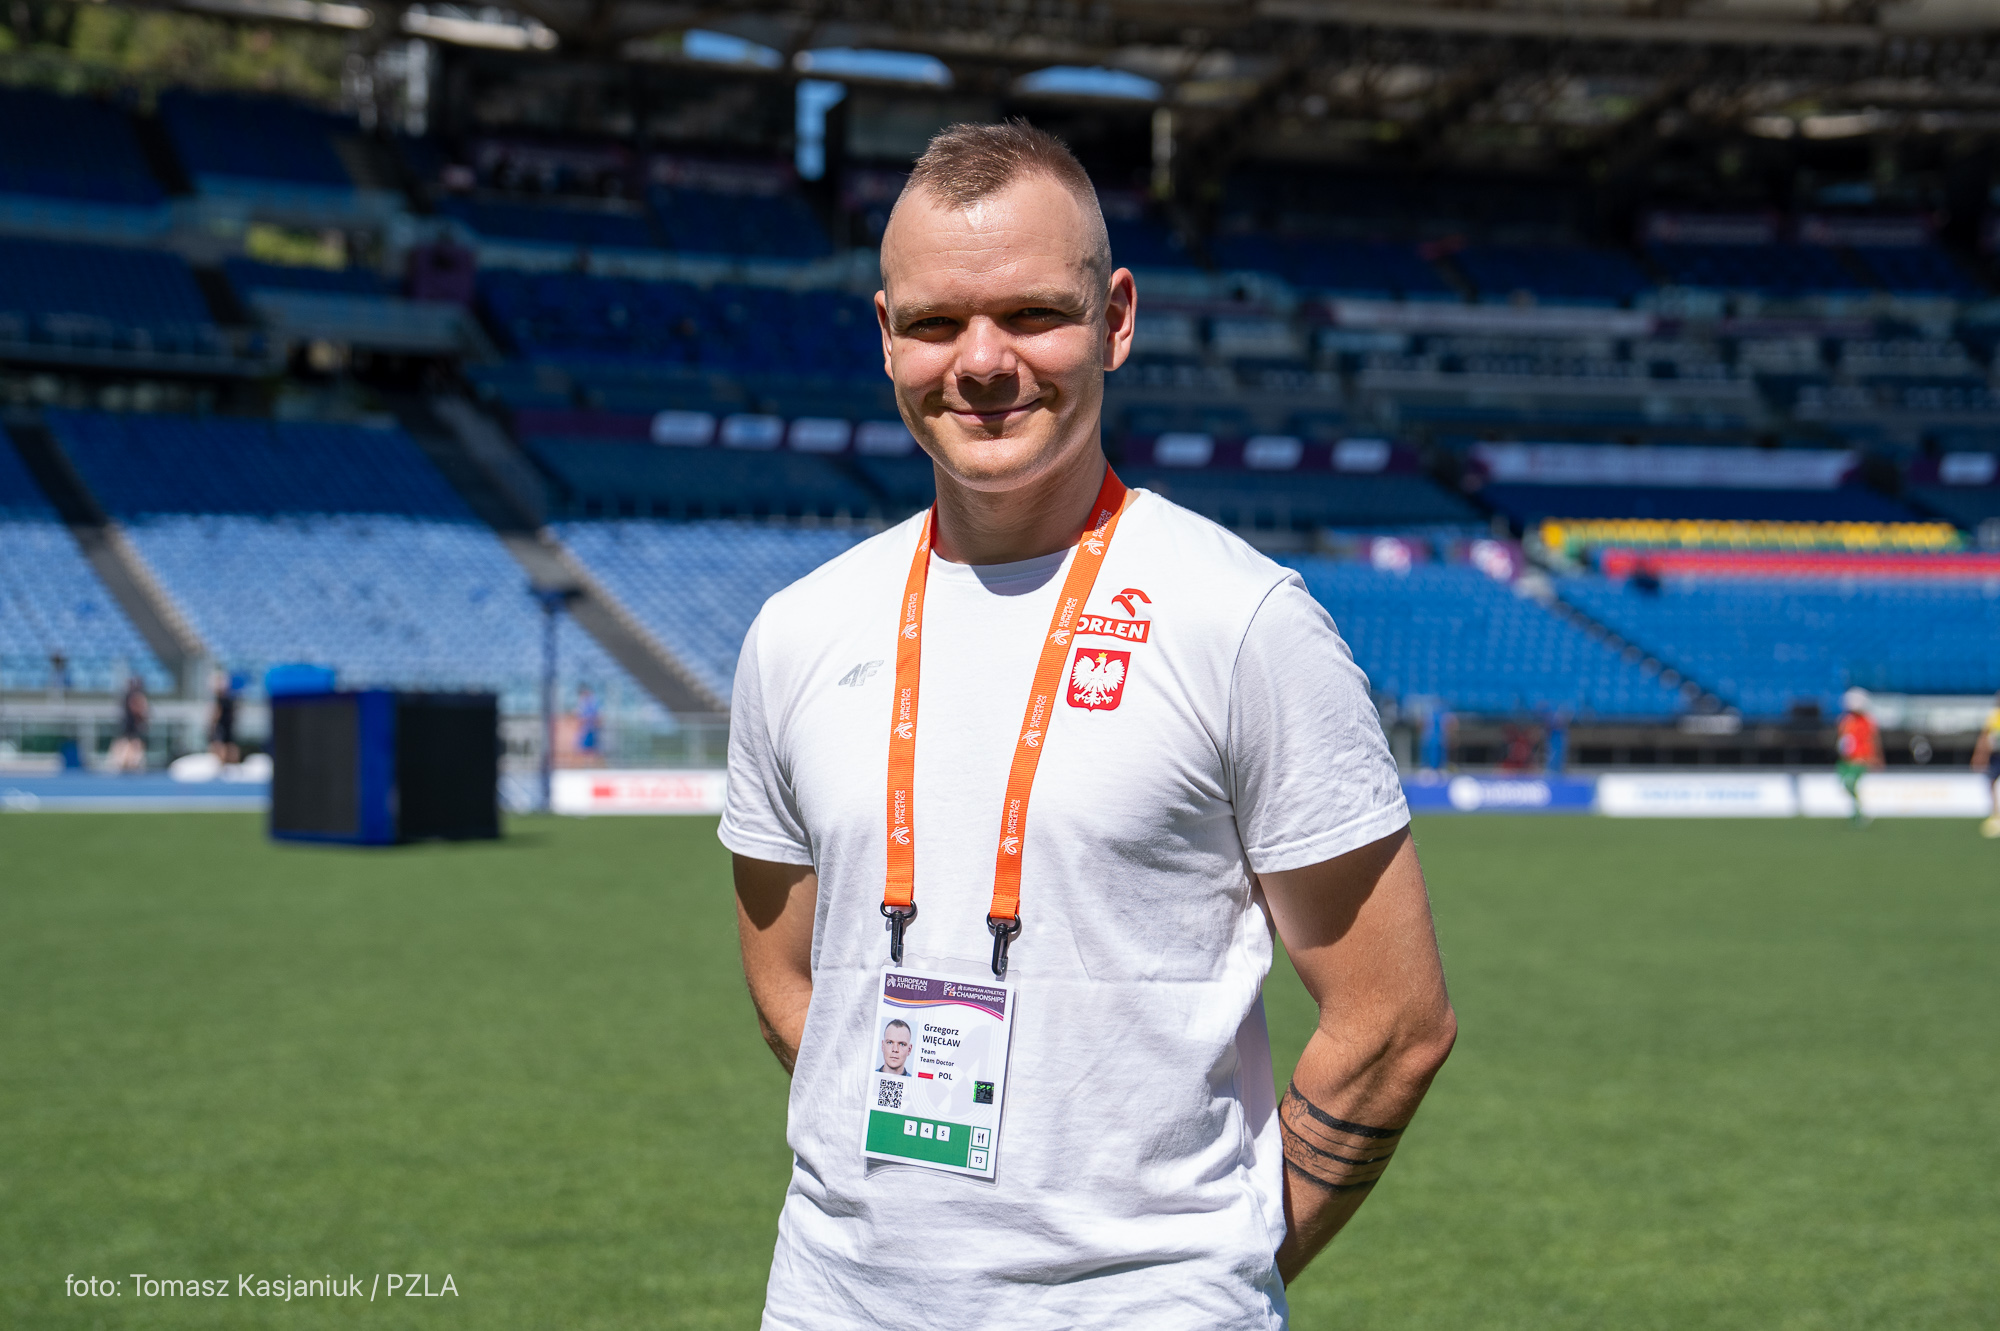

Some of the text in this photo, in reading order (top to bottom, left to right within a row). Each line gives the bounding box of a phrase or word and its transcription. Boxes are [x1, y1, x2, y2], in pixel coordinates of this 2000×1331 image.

[906, 593, 914, 623] EUROPEAN
[910, 592, 919, 622] ATHLETICS
[1058, 597, 1073, 627] EUROPEAN
[1063, 598, 1078, 628] ATHLETICS
[1075, 616, 1145, 639] ORLEN
[899, 688, 907, 720] EUROPEAN
[904, 687, 912, 720] ATHLETICS
[1029, 694, 1042, 728] EUROPEAN
[1034, 695, 1048, 728] ATHLETICS
[1006, 799, 1016, 833] EUROPEAN
[1011, 799, 1021, 834] ATHLETICS
[896, 982, 927, 991] ATHLETICS
[897, 976, 928, 986] EUROPEAN
[956, 991, 1005, 1003] CHAMPIONSHIPS
[922, 1034, 961, 1048] WIĘCŁAW
[924, 1023, 959, 1036] Grzegorz
[920, 1056, 955, 1066] Team Doctor
[938, 1071, 953, 1080] POL
[975, 1156, 983, 1164] T3
